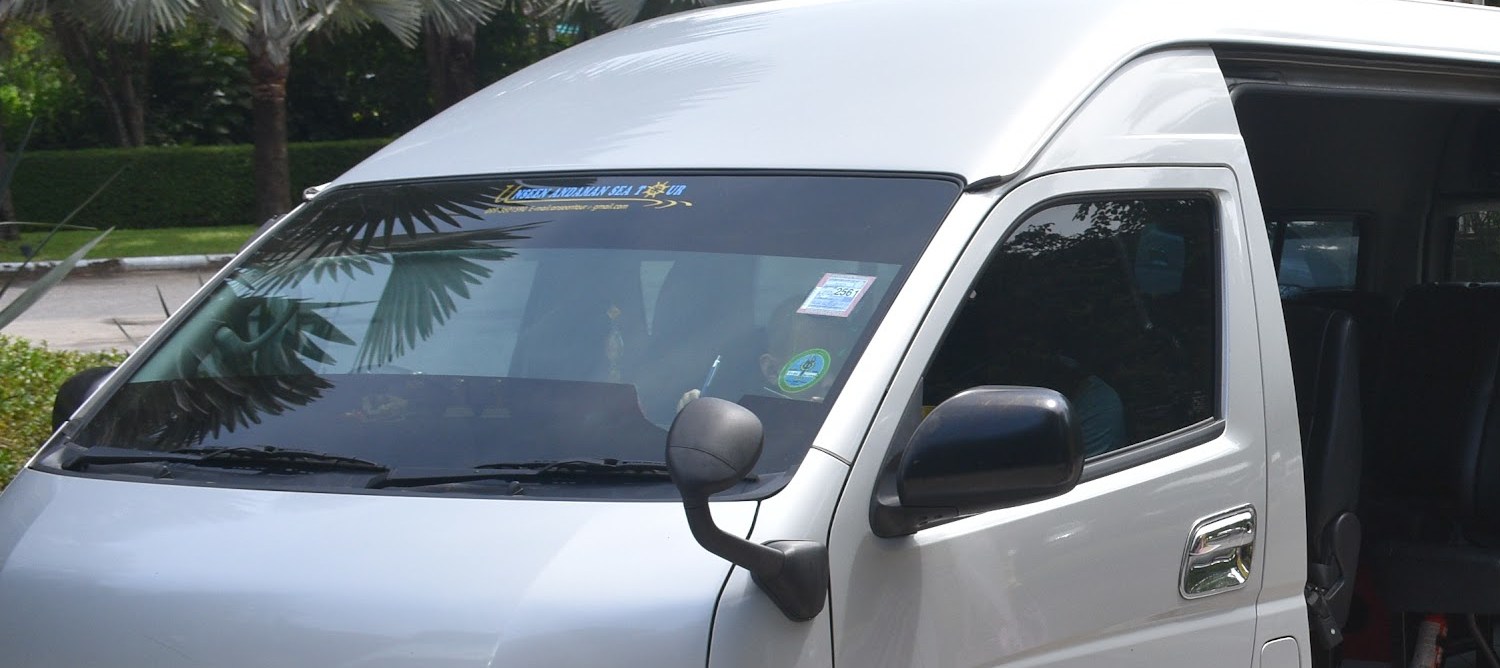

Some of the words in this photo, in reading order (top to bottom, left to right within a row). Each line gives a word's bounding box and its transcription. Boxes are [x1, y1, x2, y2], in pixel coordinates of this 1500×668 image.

[494, 184, 550, 203] UNSEEN
[548, 185, 609, 198] ANDAMAN
[608, 185, 633, 196] SEA
[834, 287, 859, 297] 2561
